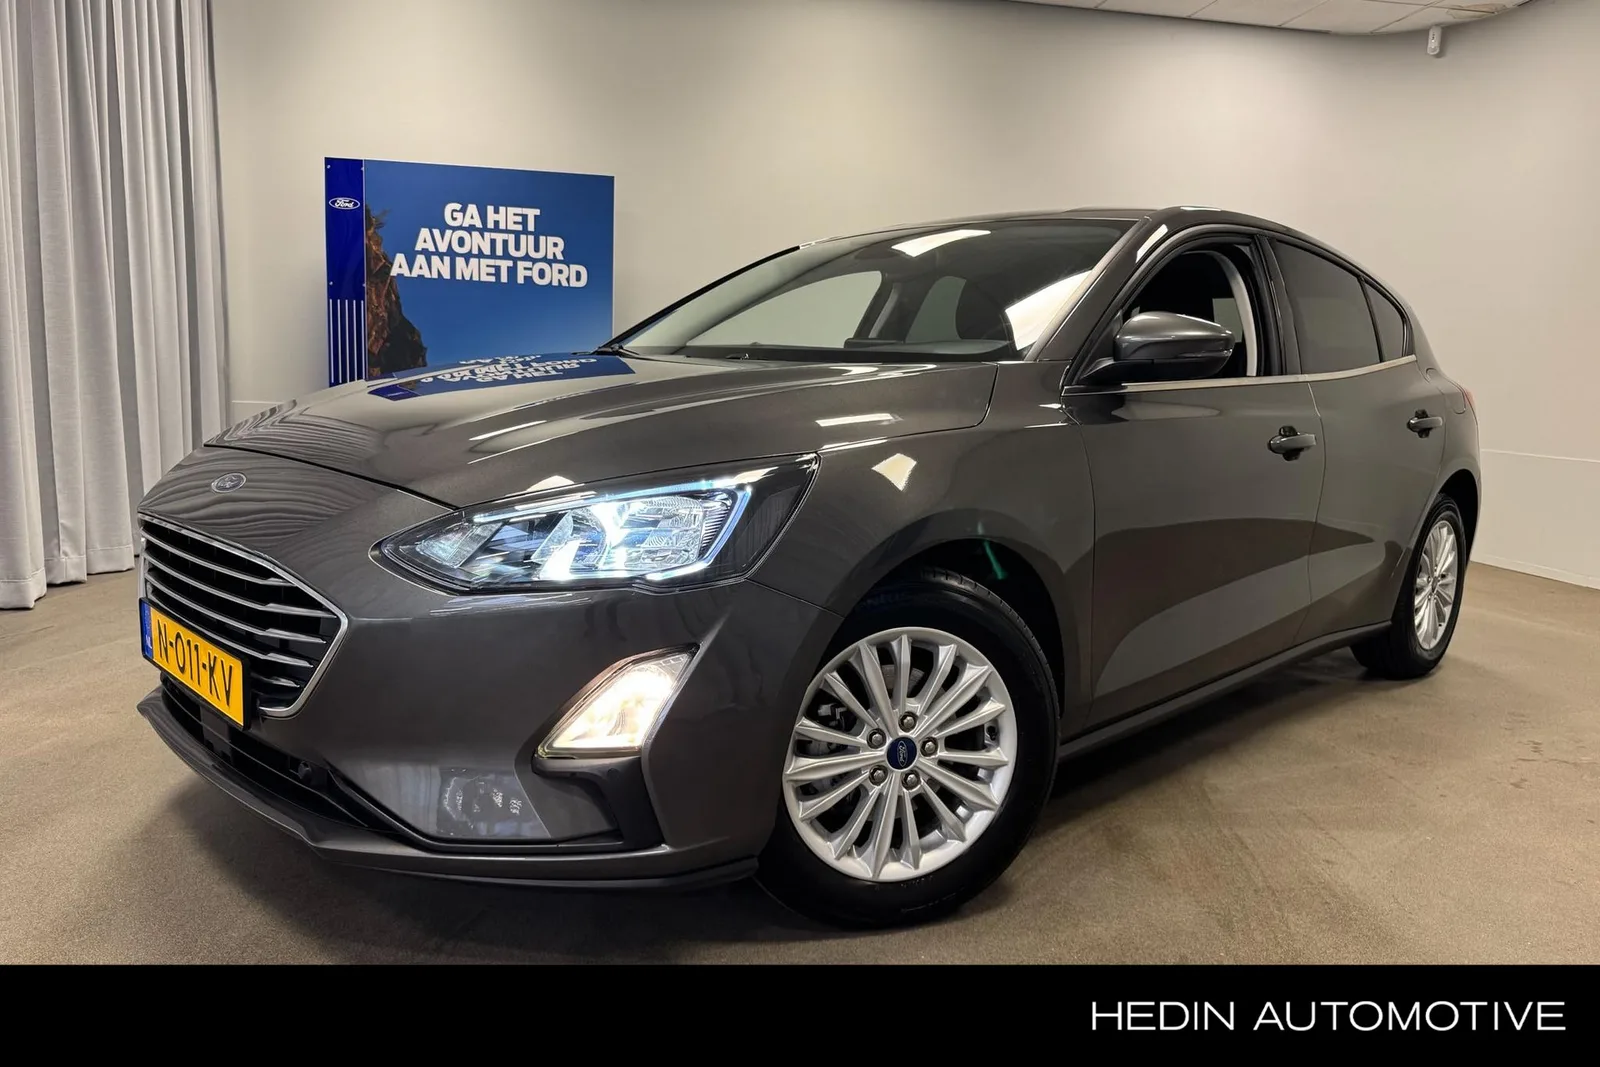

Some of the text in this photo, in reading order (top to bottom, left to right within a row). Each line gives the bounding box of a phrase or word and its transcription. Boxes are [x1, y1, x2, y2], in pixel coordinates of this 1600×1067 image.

[444, 202, 541, 232] GA HET
[414, 227, 565, 260] AVONTUUR
[390, 253, 588, 288] AAN MET FORD
[156, 618, 234, 708] N-011-KV
